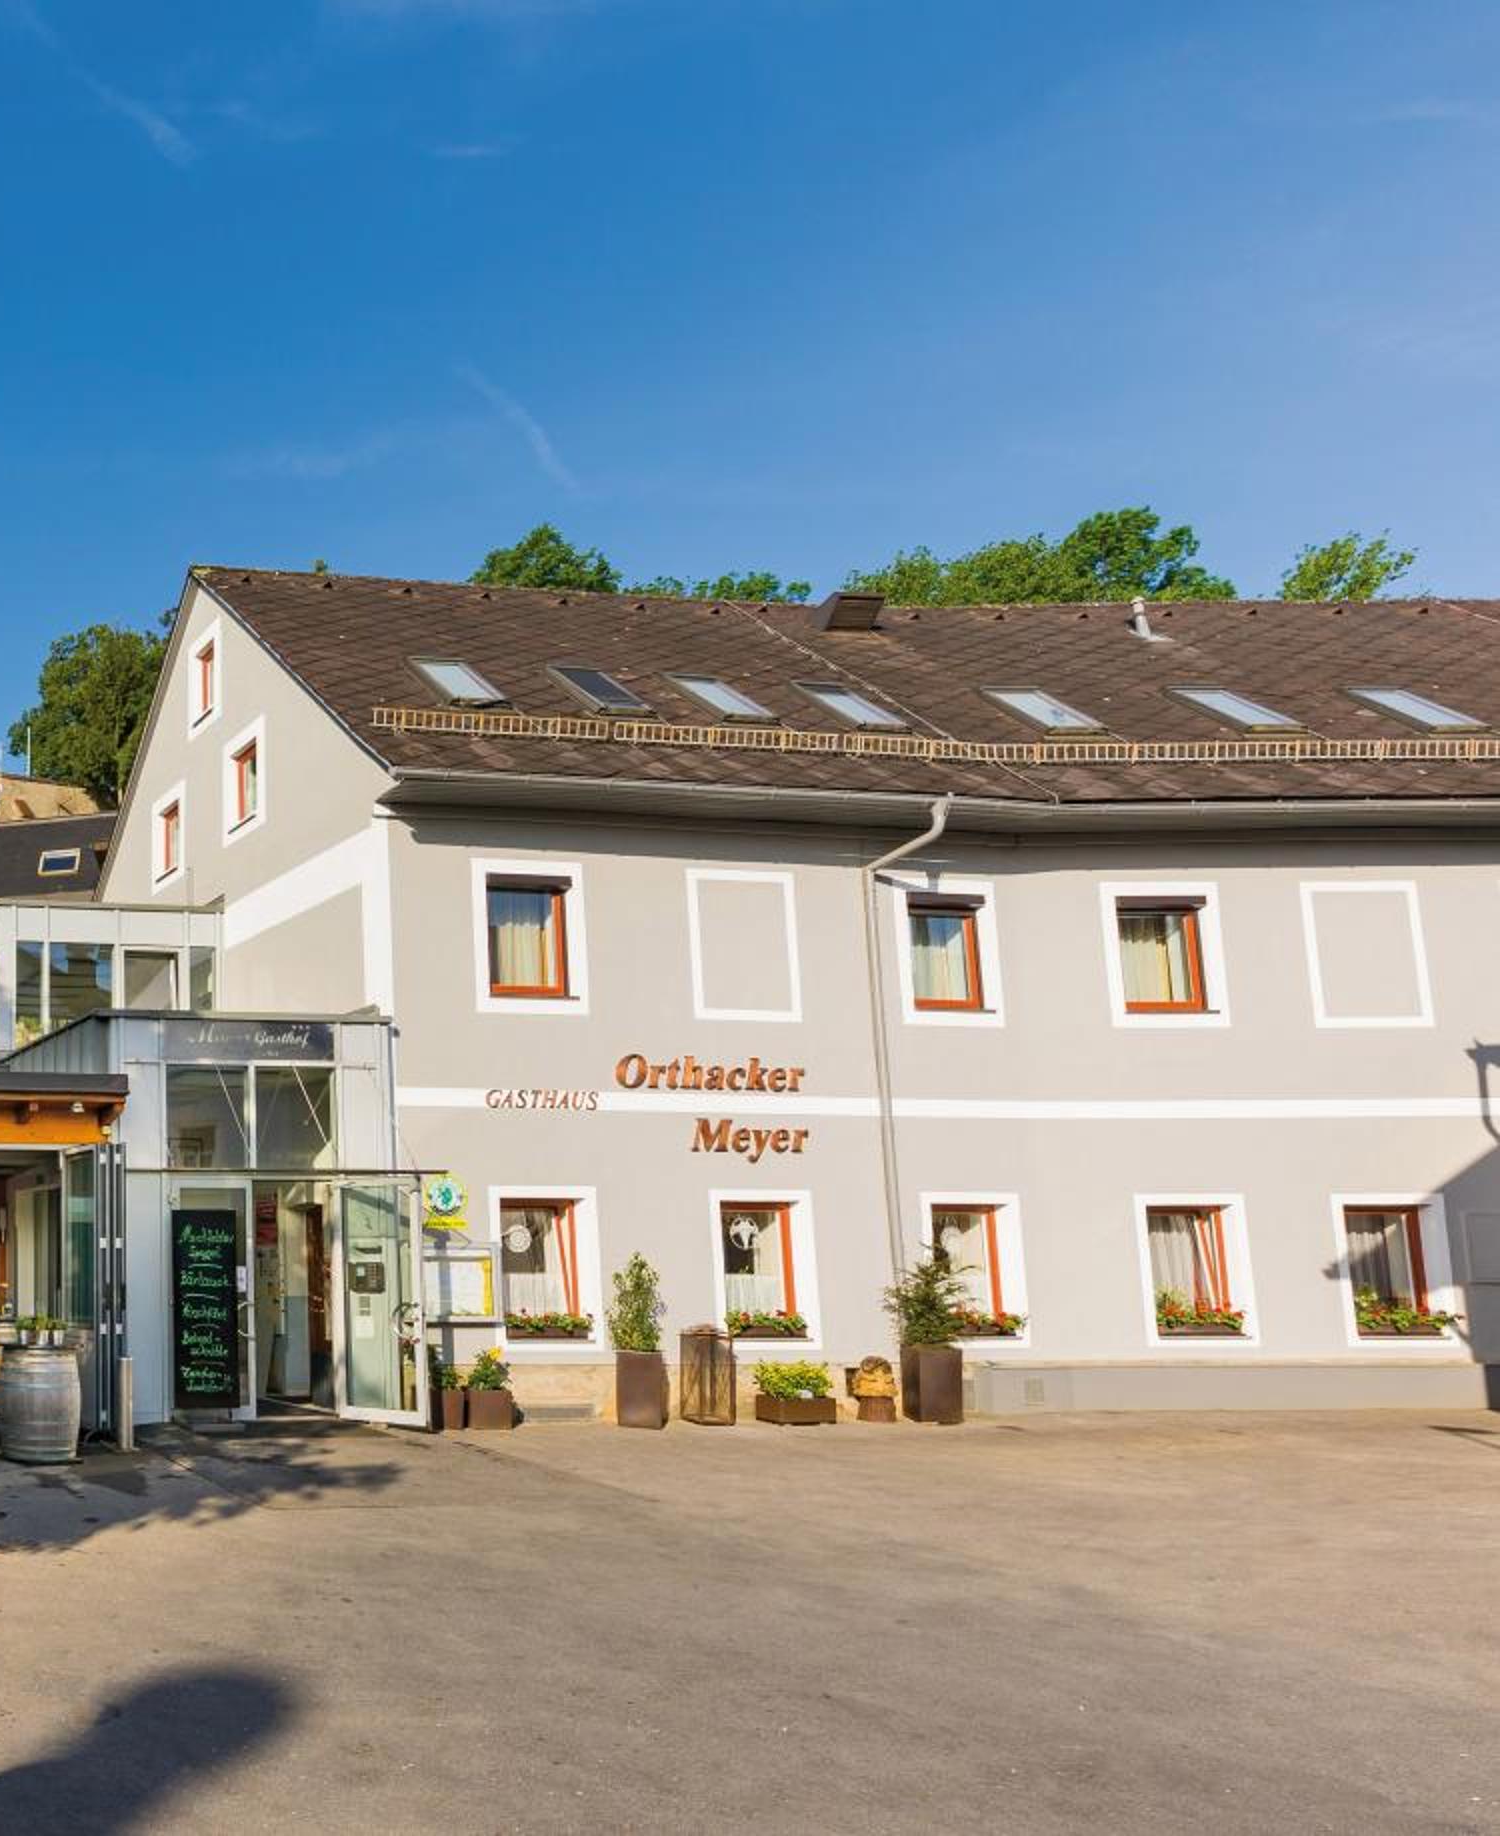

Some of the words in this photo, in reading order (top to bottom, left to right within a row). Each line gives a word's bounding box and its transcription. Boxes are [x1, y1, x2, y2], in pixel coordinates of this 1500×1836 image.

[615, 1053, 805, 1092] Orthacker
[485, 1089, 599, 1111] GASTHAUS
[691, 1117, 809, 1164] Meyer
